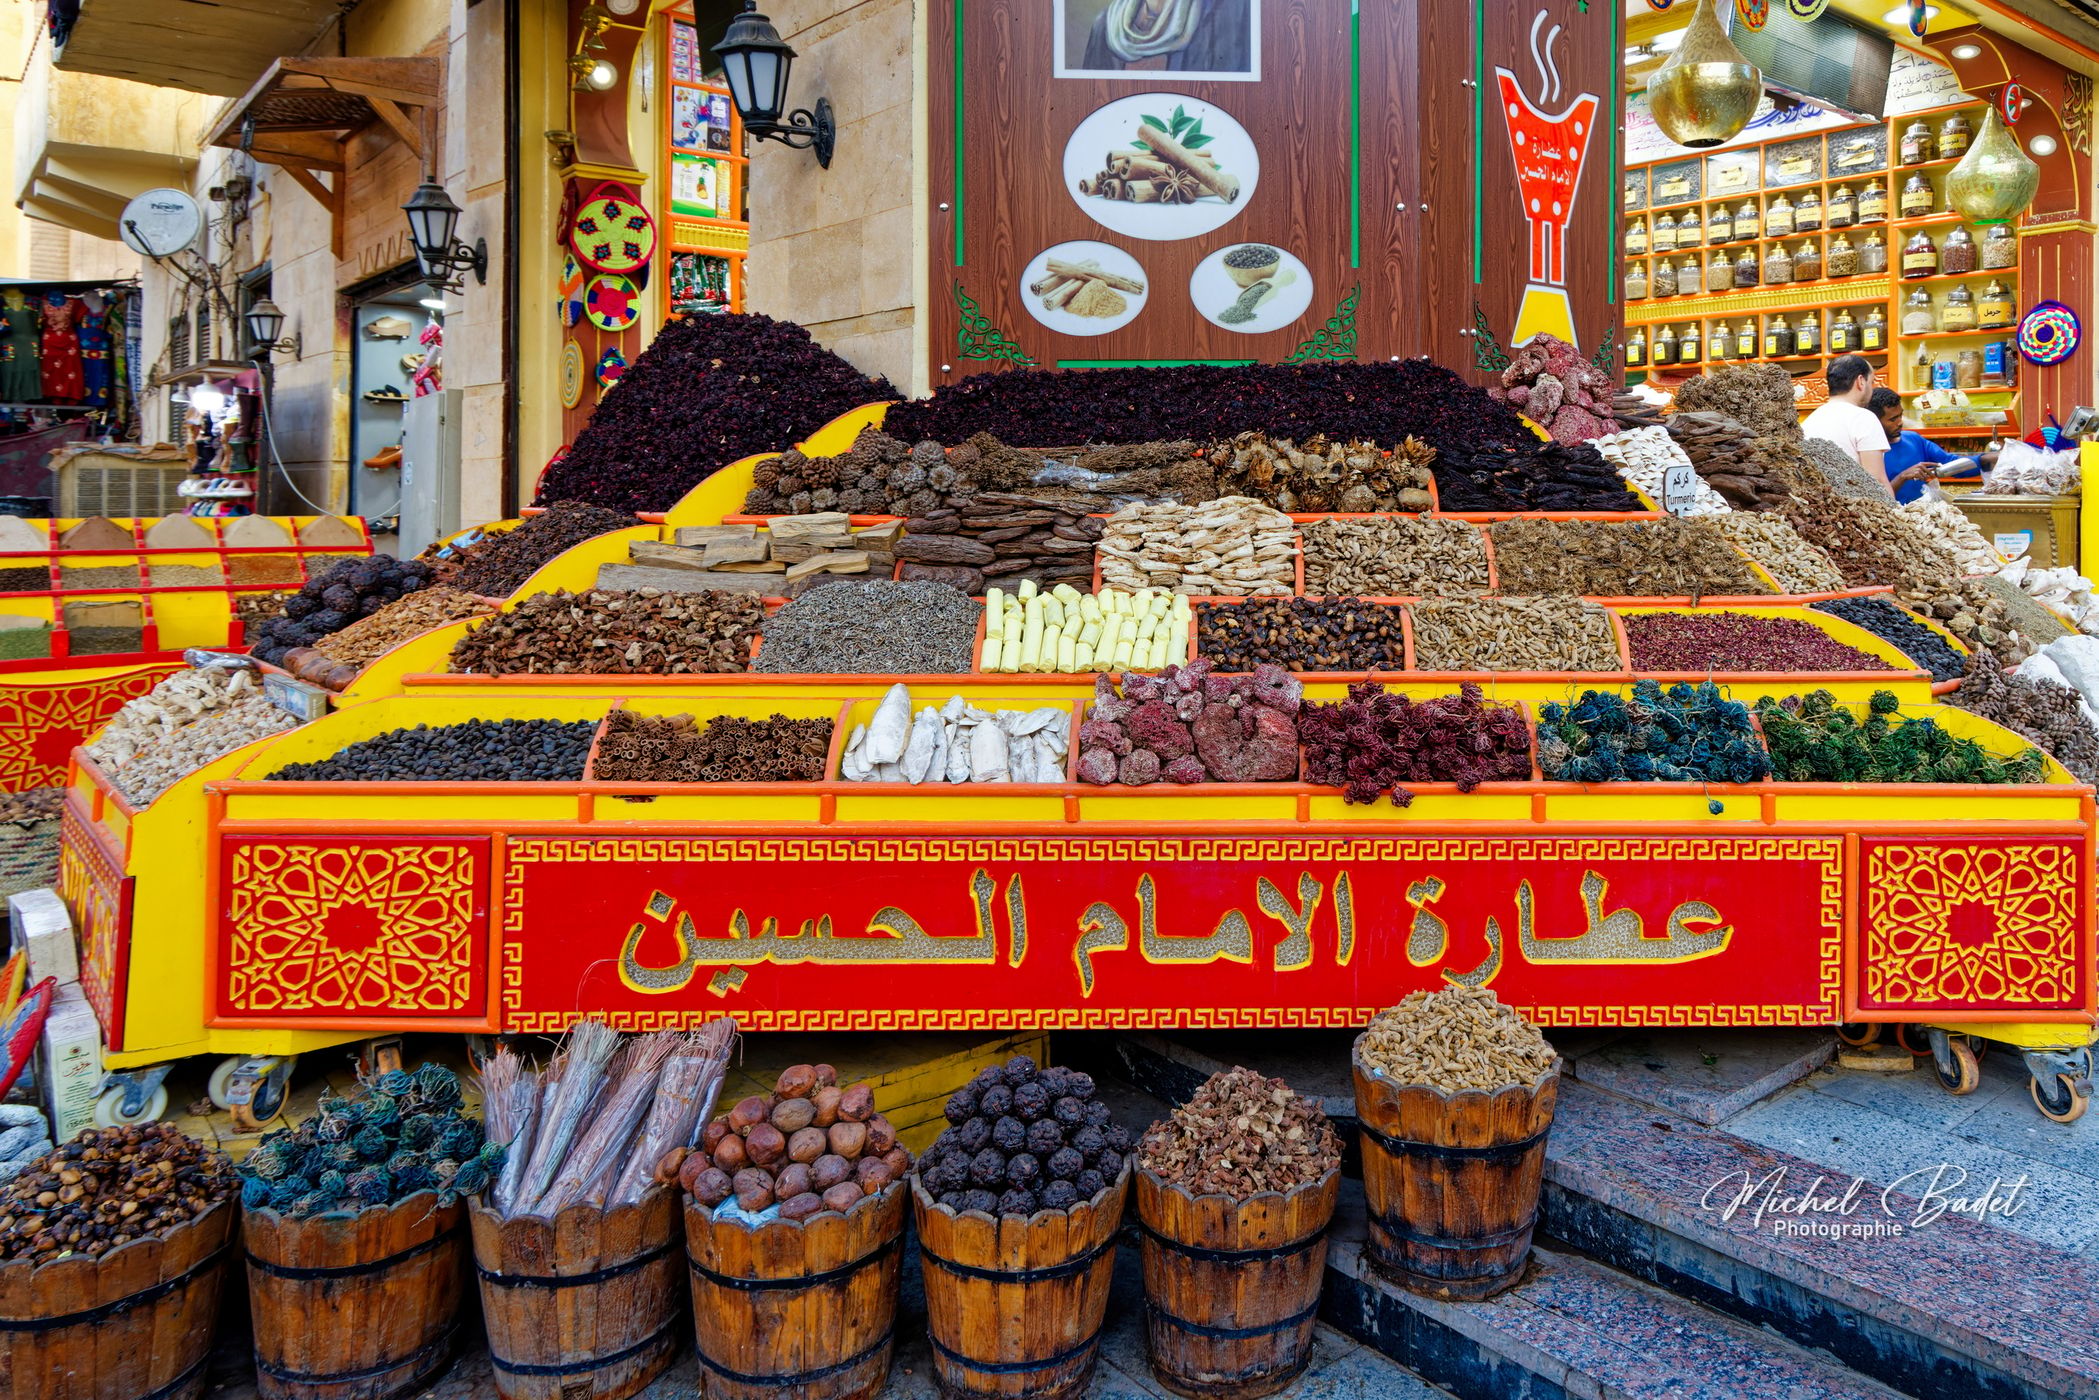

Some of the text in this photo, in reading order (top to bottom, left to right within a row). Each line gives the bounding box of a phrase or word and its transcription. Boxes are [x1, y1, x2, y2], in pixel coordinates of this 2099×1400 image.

[1532, 136, 1561, 160] عطارة
[1520, 159, 1550, 182] الحسين
[1672, 471, 1689, 492] كركم
[1666, 493, 1696, 505] Turmeric
[617, 866, 1735, 998] عطارة الامام الحسين
